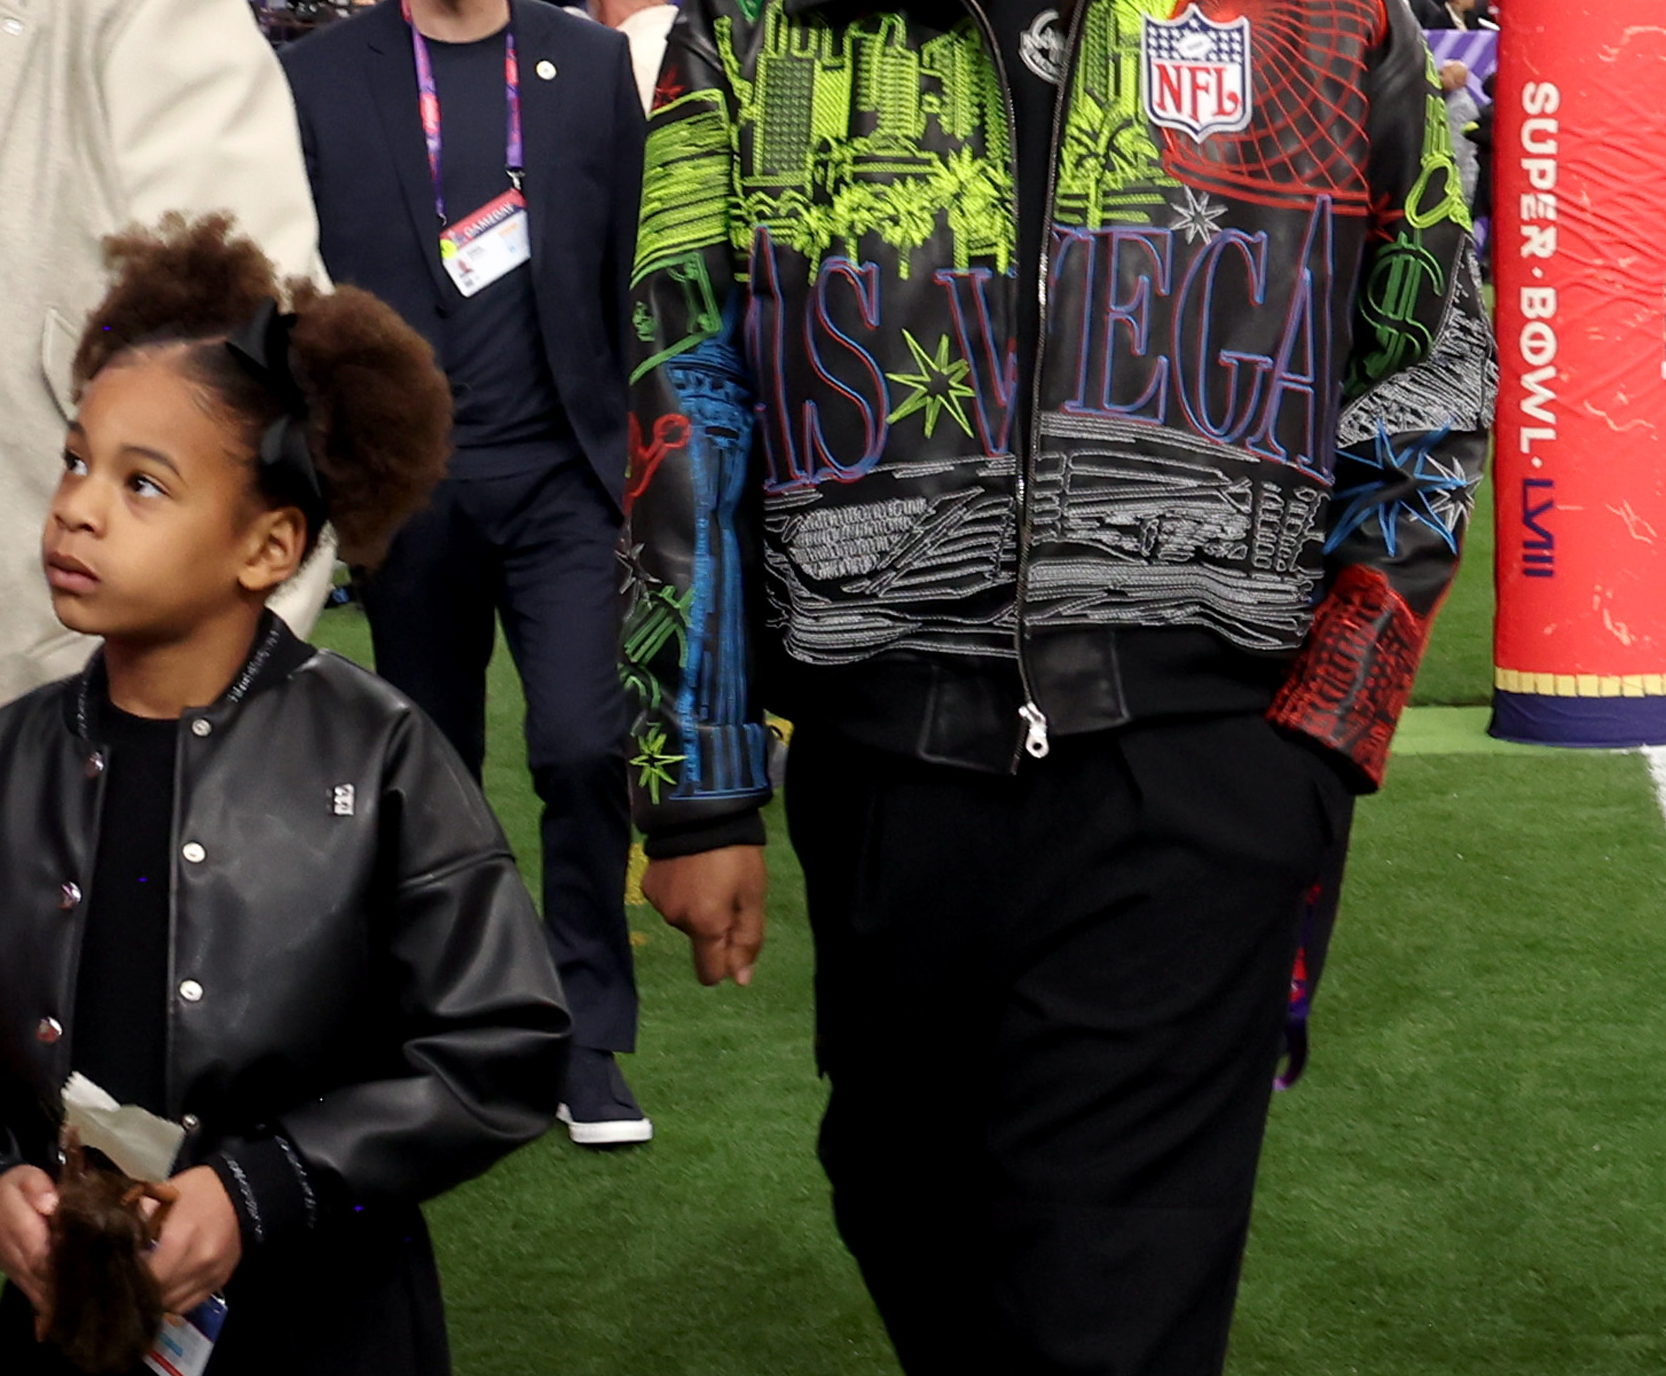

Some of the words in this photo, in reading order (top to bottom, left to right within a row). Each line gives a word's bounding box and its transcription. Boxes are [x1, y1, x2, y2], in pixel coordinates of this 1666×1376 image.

[1153, 63, 1241, 123] NFL
[1520, 81, 1561, 259] SUPER
[1519, 286, 1558, 455] BOWL
[1521, 477, 1555, 578] LVIII
